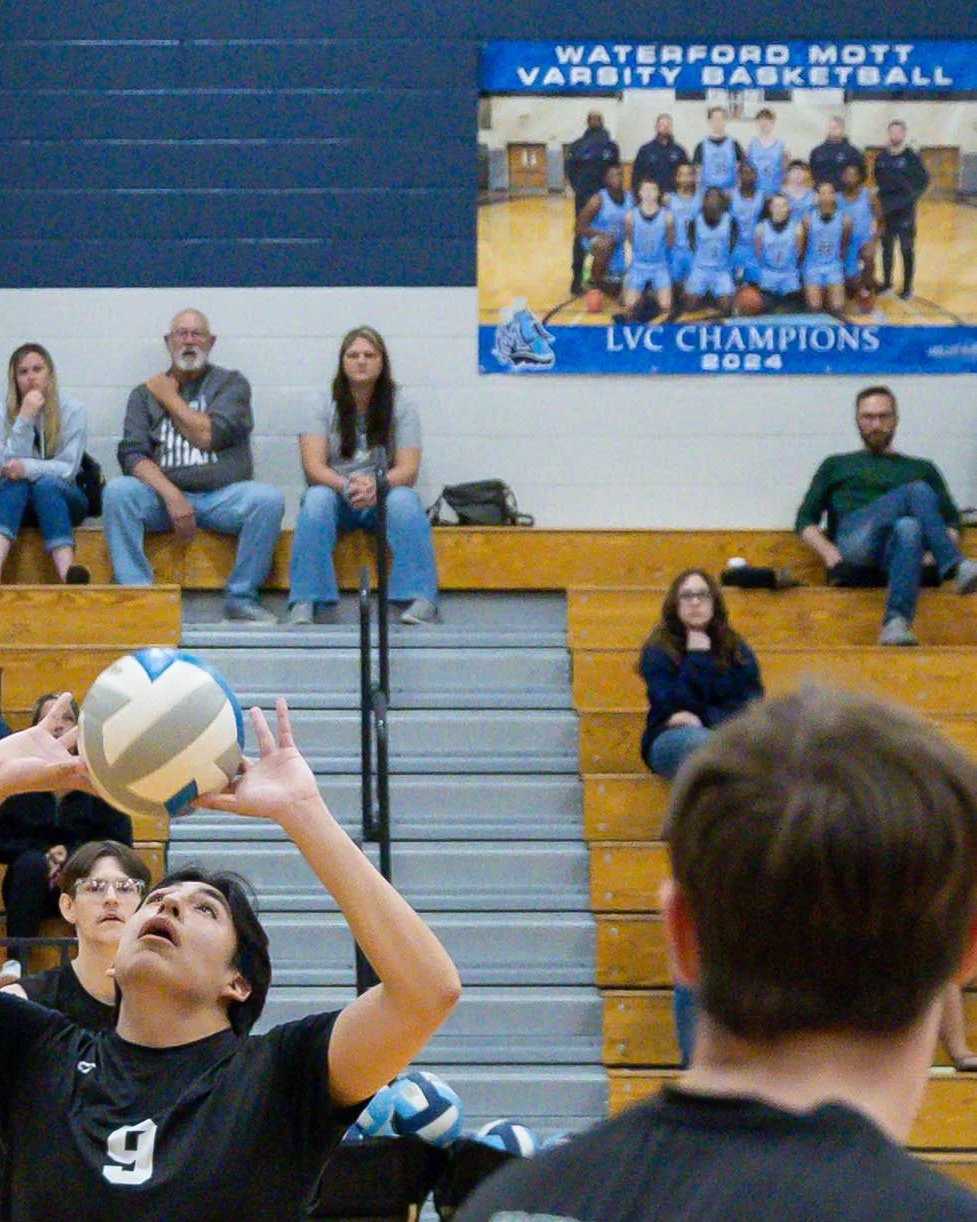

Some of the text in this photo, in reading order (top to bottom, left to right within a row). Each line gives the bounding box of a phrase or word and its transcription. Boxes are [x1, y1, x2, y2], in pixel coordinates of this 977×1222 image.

[554, 44, 914, 64] WATERFORD MOTT
[516, 65, 953, 86] VARSITY BASKETBALL
[606, 326, 880, 351] LVC CHAMPIONS
[700, 353, 783, 371] 2024
[102, 1118, 158, 1185] 9
